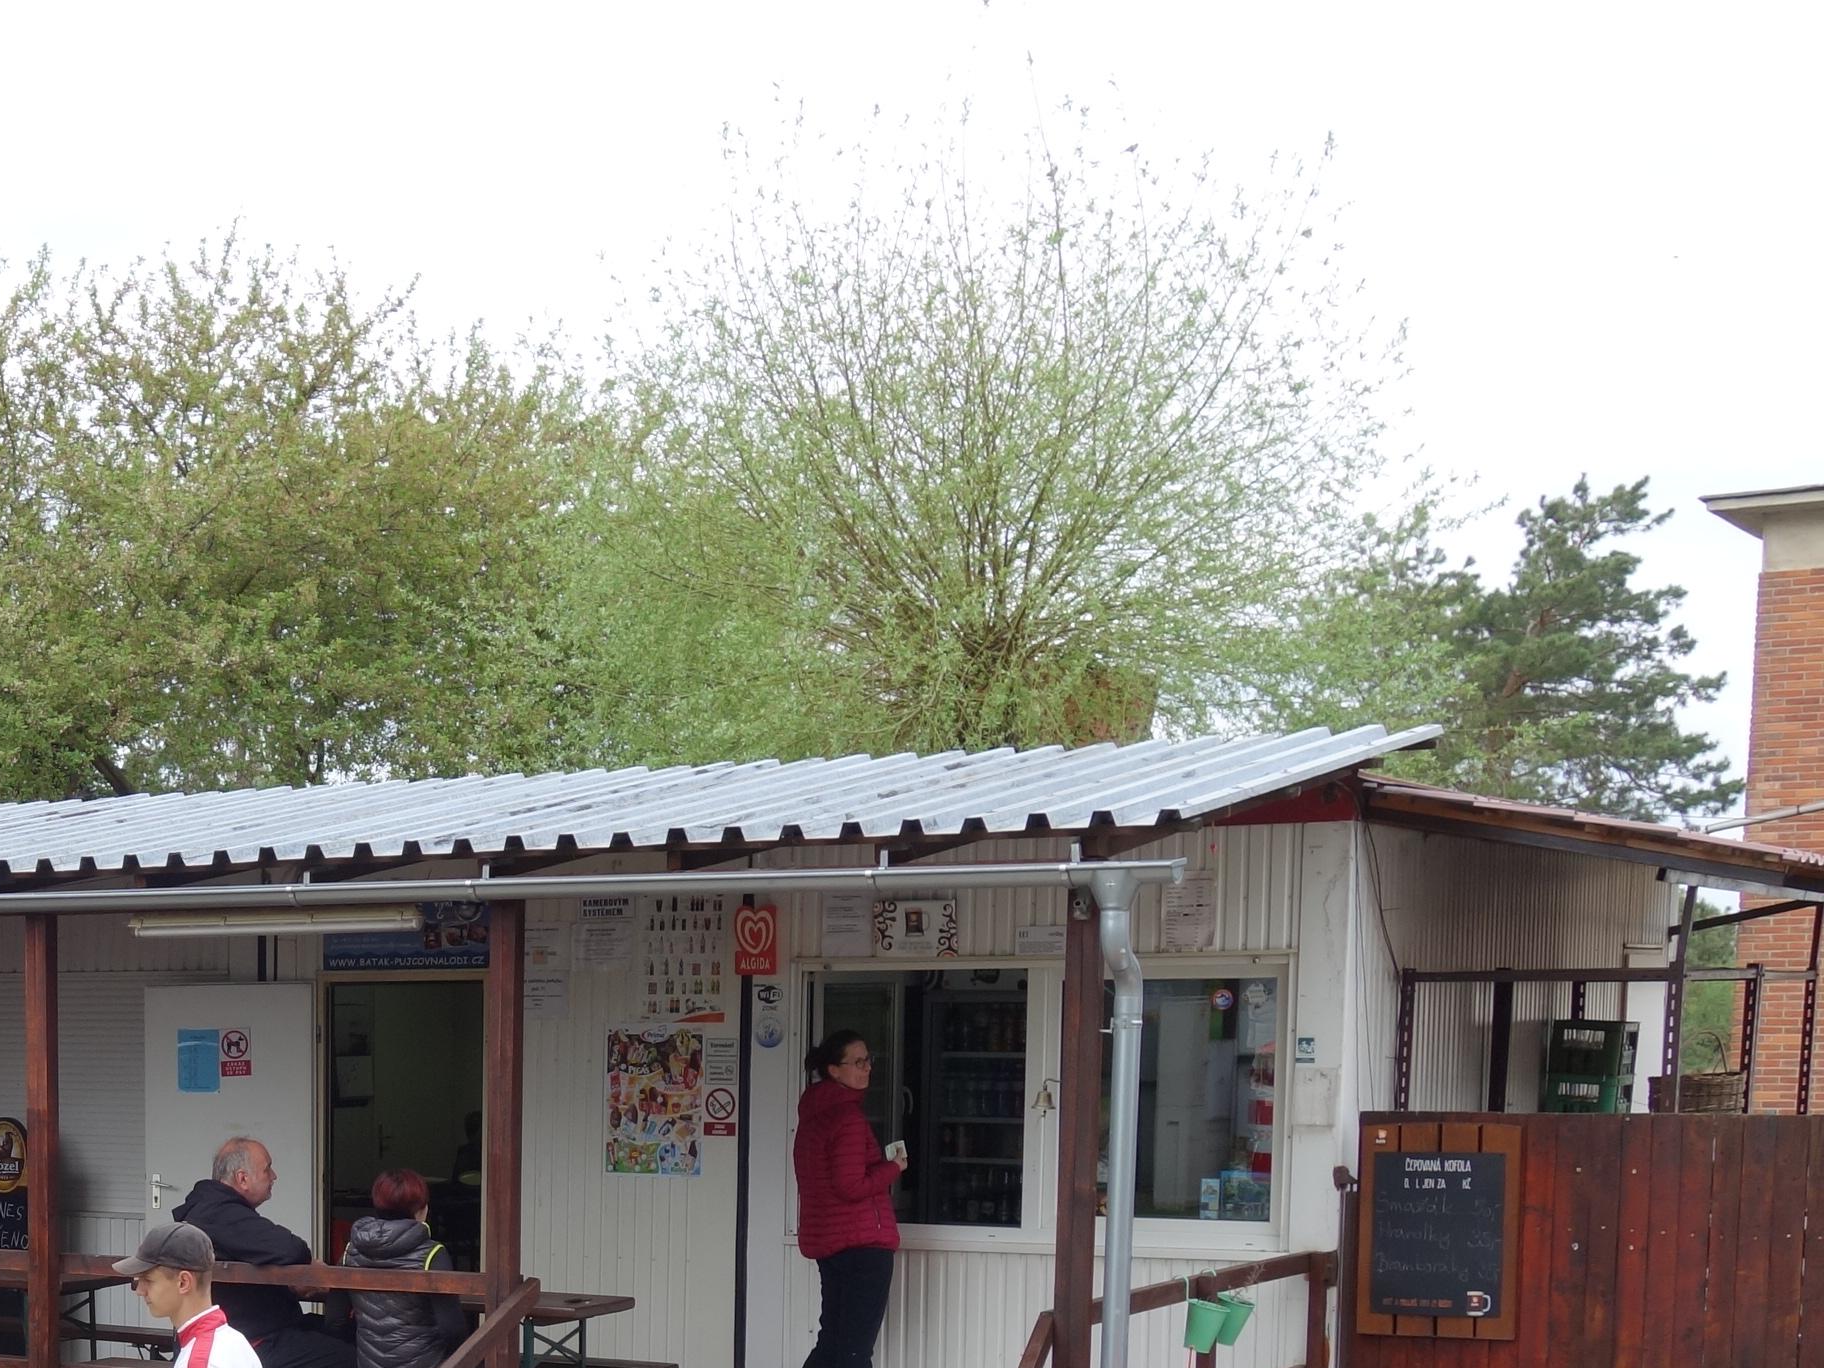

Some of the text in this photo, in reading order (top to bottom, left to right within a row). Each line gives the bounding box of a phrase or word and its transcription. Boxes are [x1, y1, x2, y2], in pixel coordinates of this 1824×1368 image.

[740, 957, 771, 970] ALGIDA
[1405, 1157, 1472, 1172] ČEPOVANÁ KOFOLA
[1437, 1178, 1447, 1189] ZA
